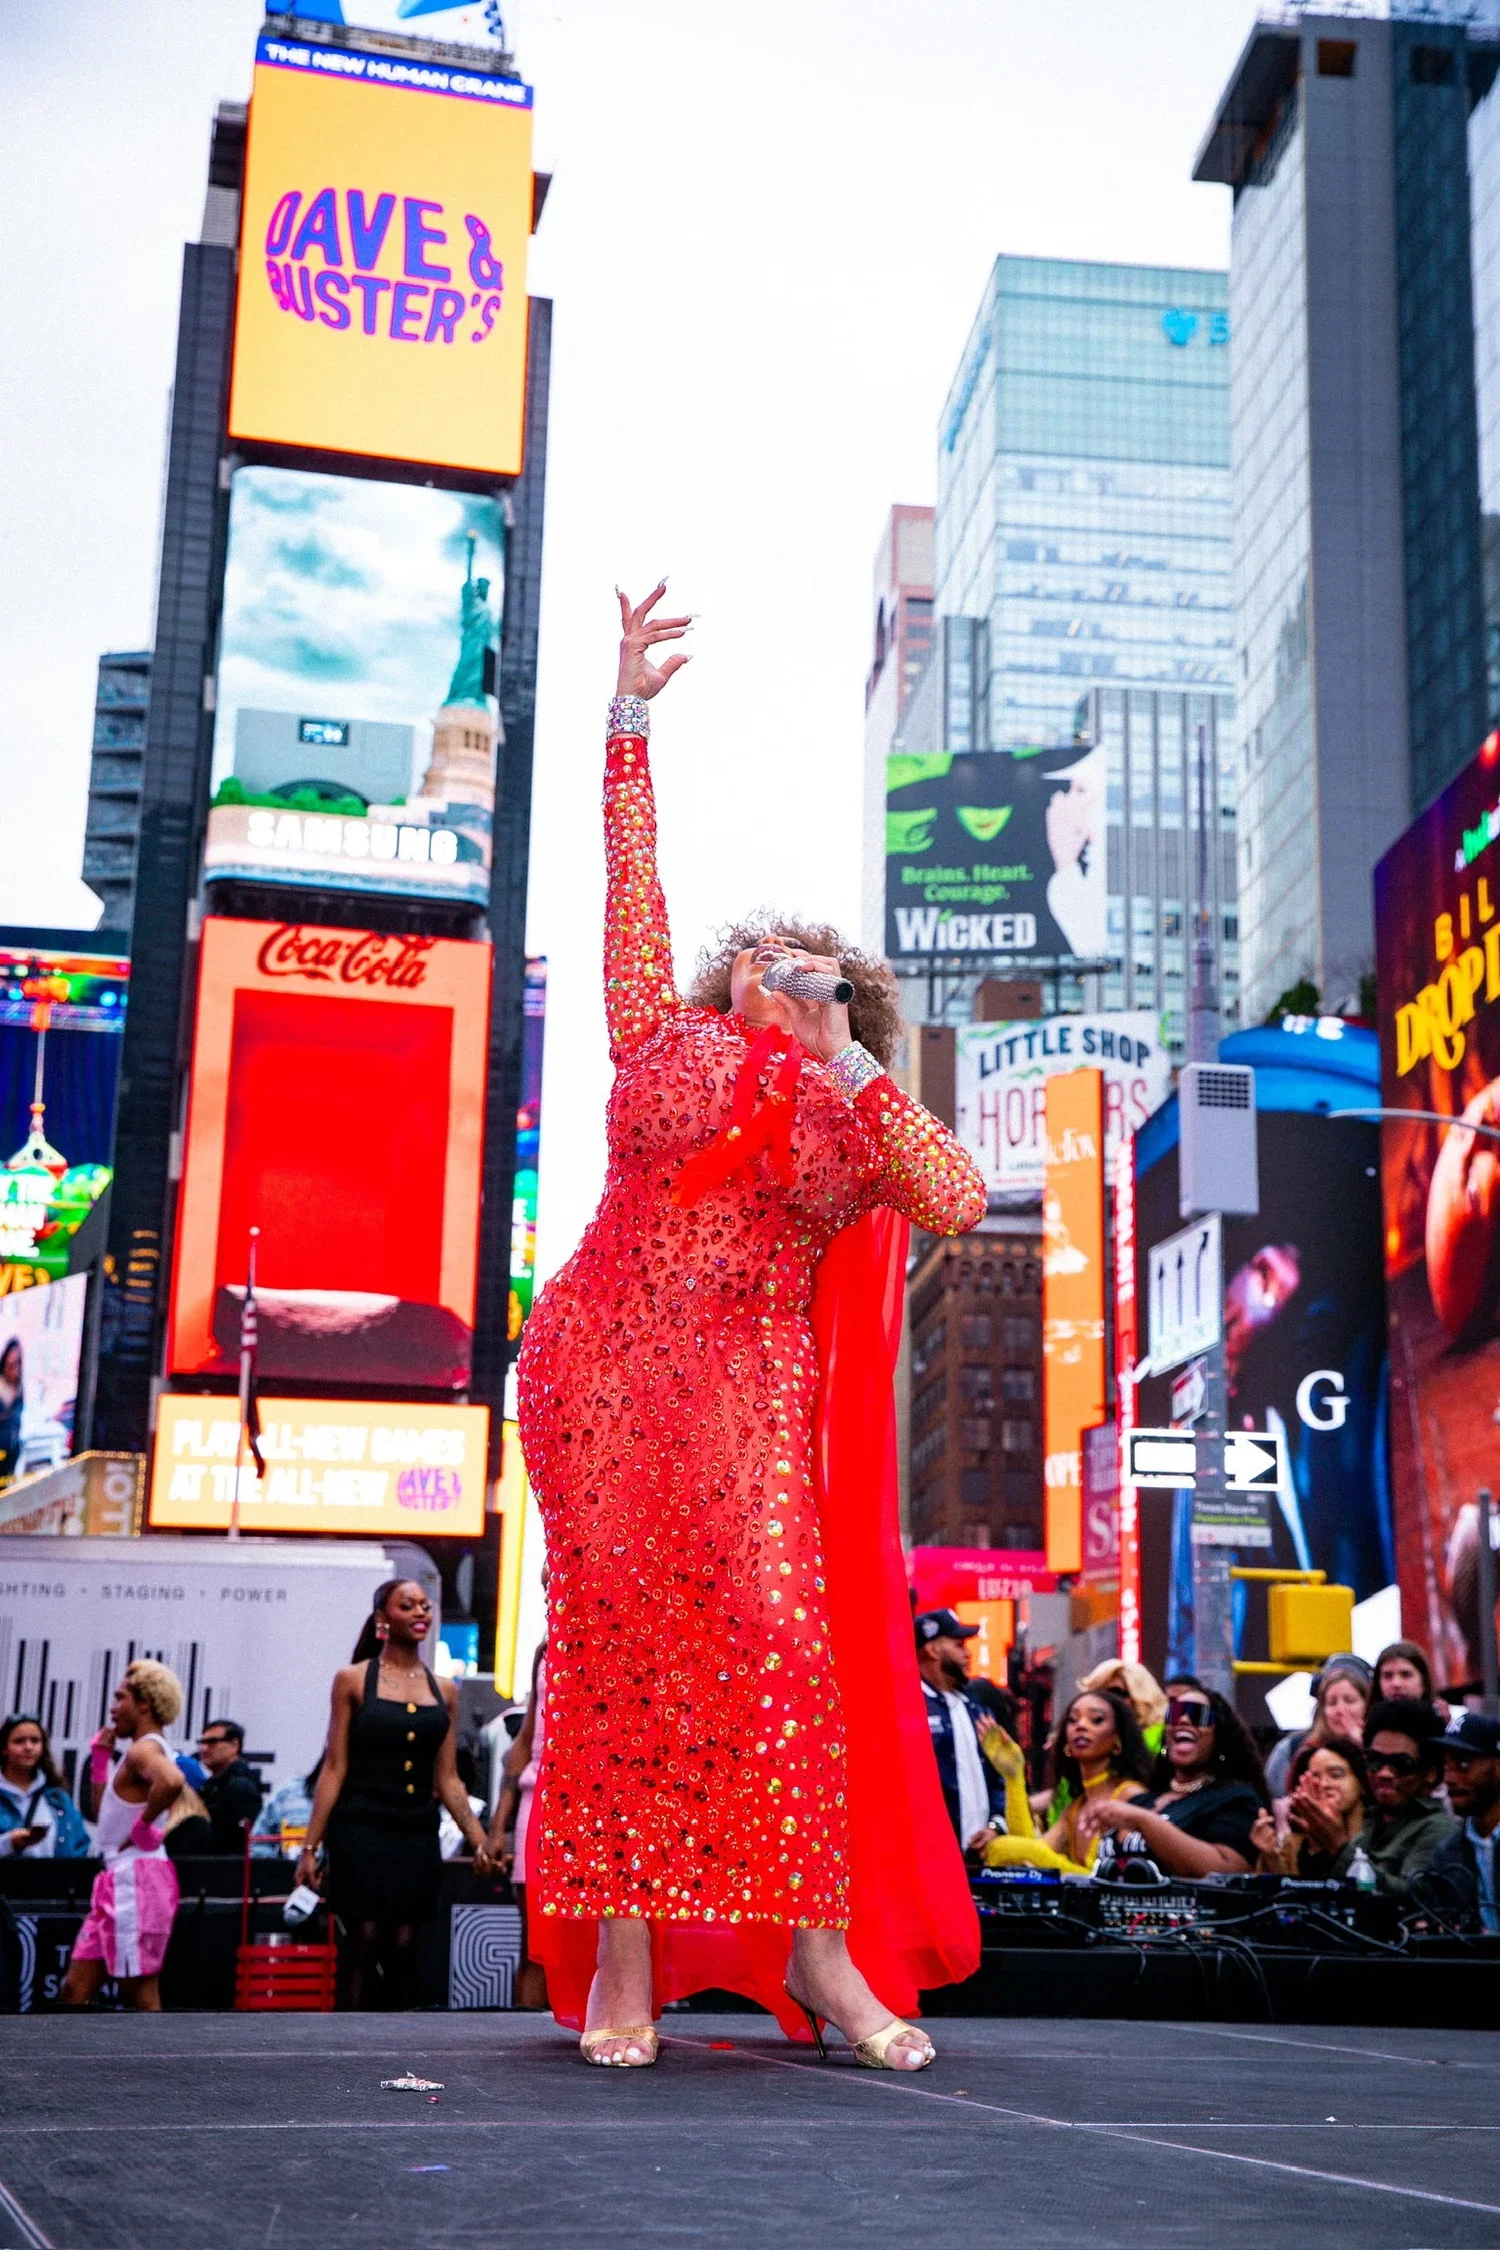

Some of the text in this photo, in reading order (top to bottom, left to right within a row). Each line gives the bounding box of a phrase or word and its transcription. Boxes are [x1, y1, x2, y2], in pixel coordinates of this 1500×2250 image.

[265, 43, 312, 66] THE
[311, 51, 366, 75] NEW
[367, 61, 450, 90] HUMAN
[265, 187, 504, 291] DAVE &
[265, 259, 502, 344] BUSTER'S
[246, 811, 460, 866] SAMSUNG
[258, 923, 435, 989] Coca-Cola
[979, 1027, 1151, 1080] LITTLE SHOP
[978, 1078, 1152, 1171] HORRS
[168, 1464, 207, 1501] AT
[266, 1467, 390, 1507] ALL-NEW
[102, 1584, 185, 1601] STAGING
[220, 1587, 287, 1602] POWER
